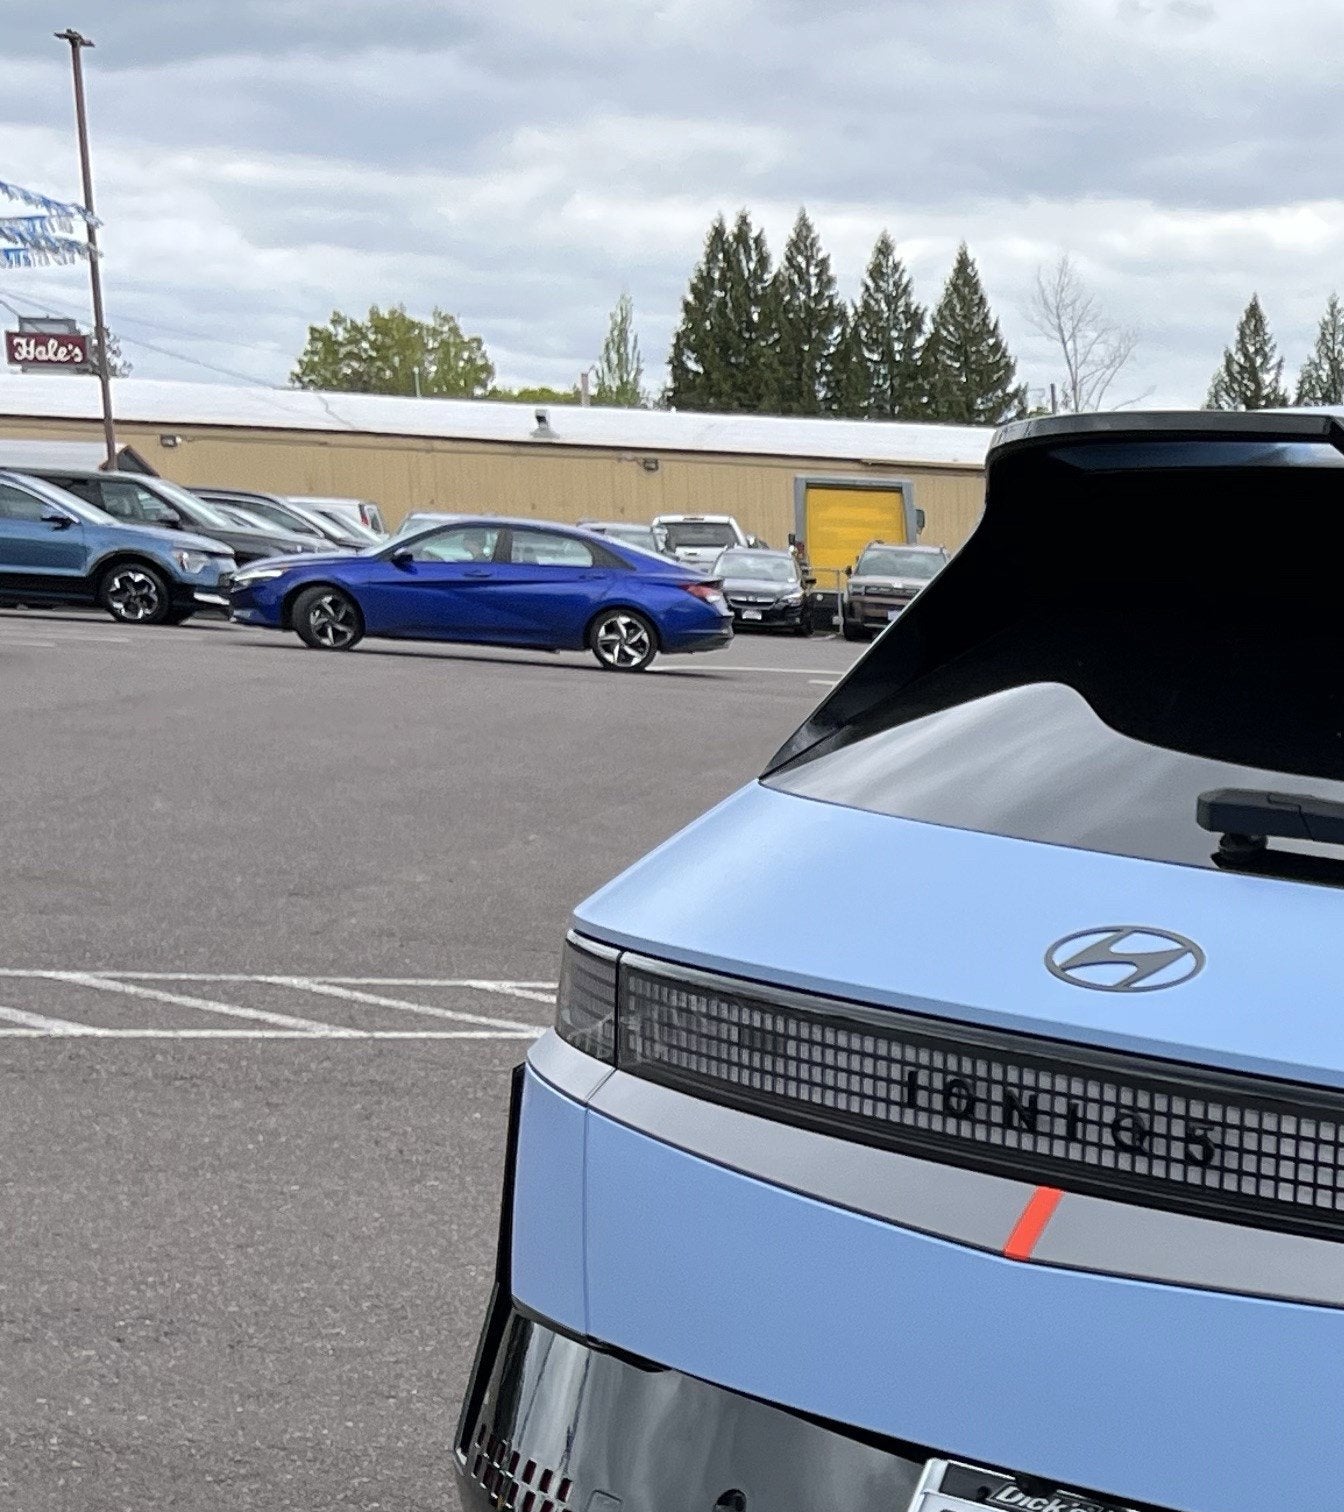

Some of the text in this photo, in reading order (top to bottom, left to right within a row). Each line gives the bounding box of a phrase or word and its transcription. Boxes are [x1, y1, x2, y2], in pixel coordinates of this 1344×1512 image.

[13, 337, 84, 363] Hale's
[904, 1069, 1217, 1168] IONIQ 5
